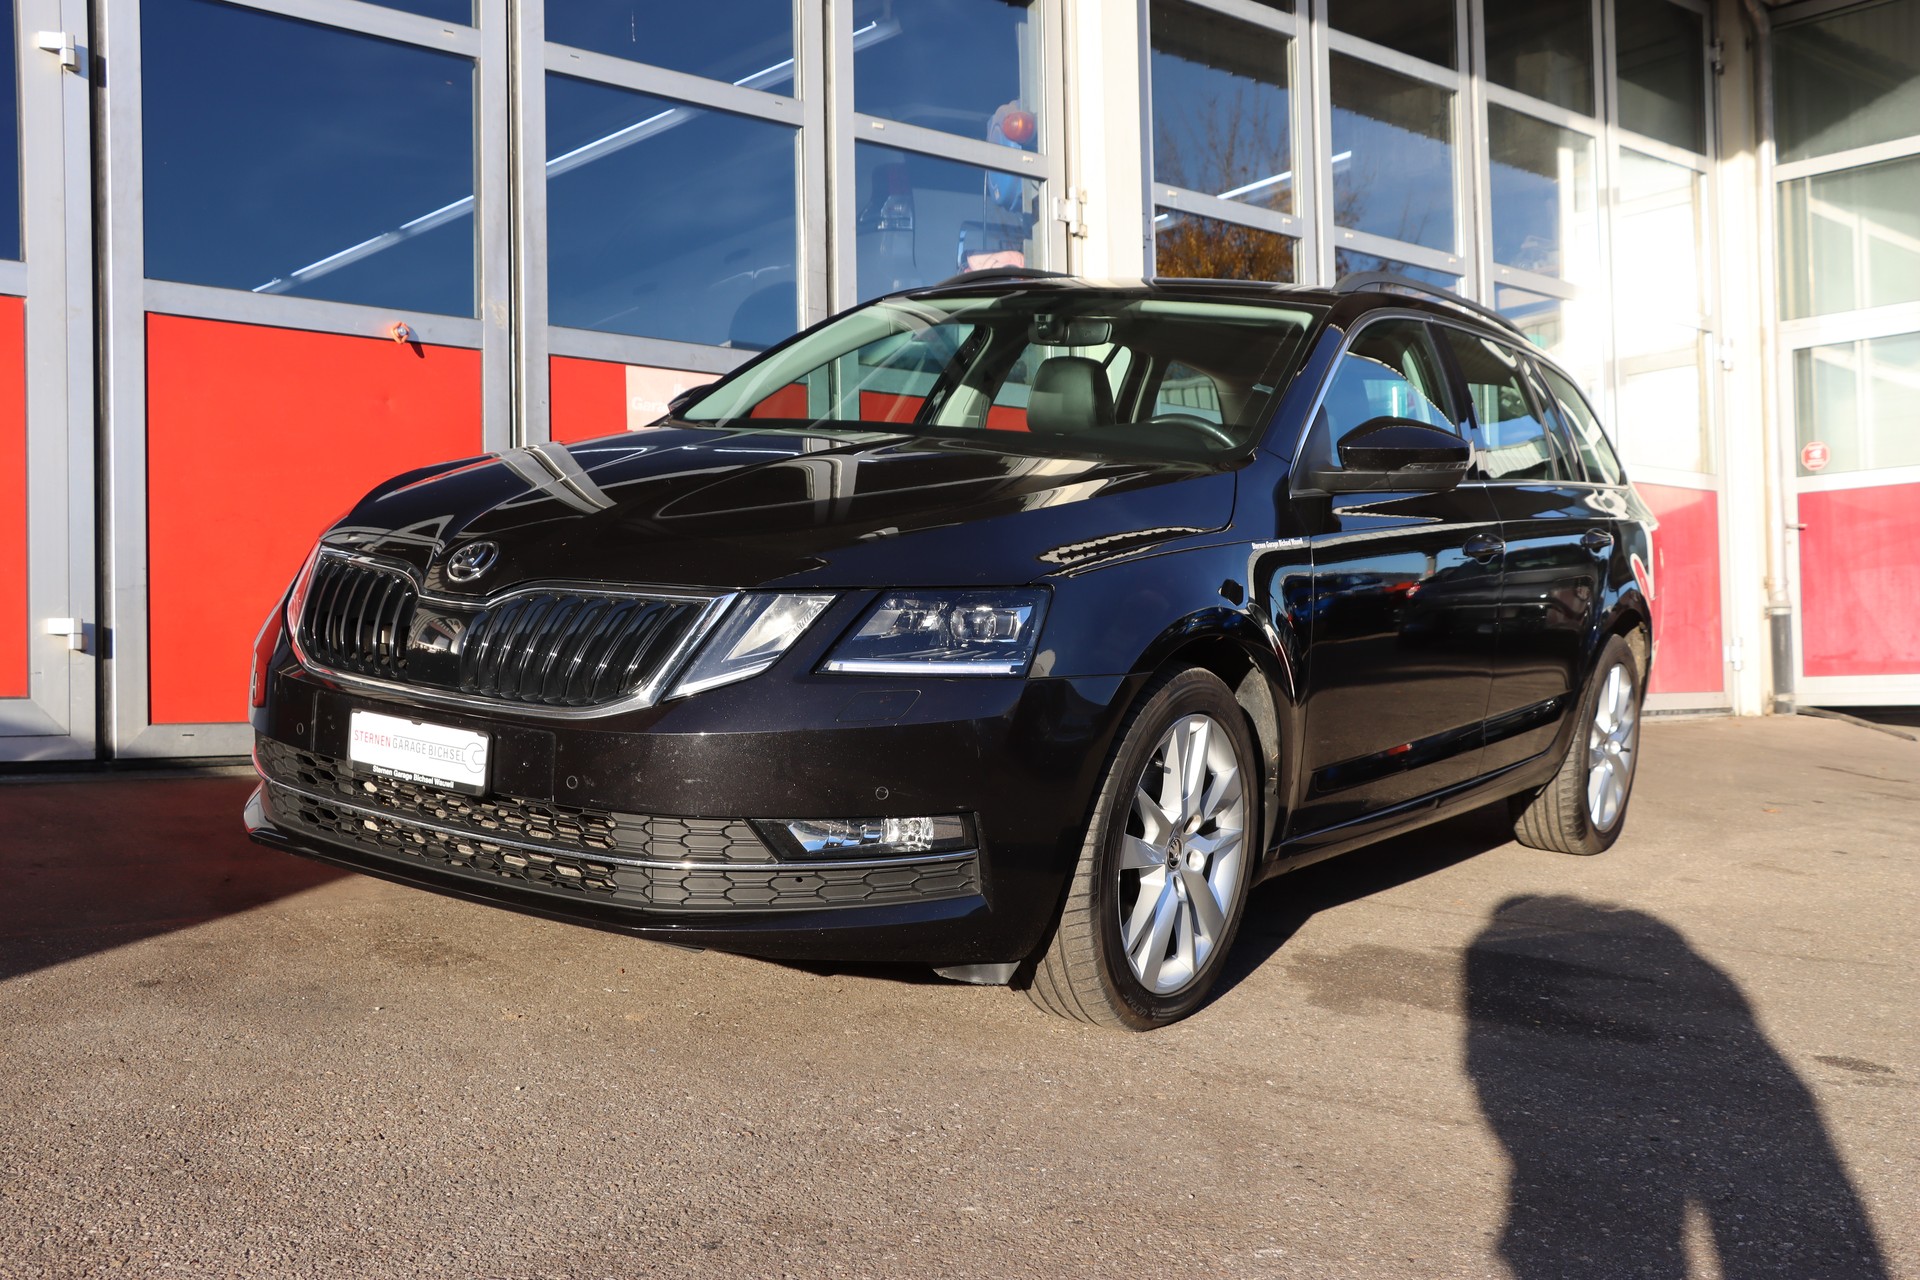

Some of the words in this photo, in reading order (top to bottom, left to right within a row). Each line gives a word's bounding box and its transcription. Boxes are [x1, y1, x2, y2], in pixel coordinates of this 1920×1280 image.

[632, 396, 667, 412] Gara
[354, 729, 391, 747] STERNEN
[392, 737, 427, 755] GARAGE
[428, 745, 466, 762] BICHSEL
[372, 765, 392, 775] Sternen
[394, 769, 413, 781] Garage
[413, 773, 433, 784] Bichsel
